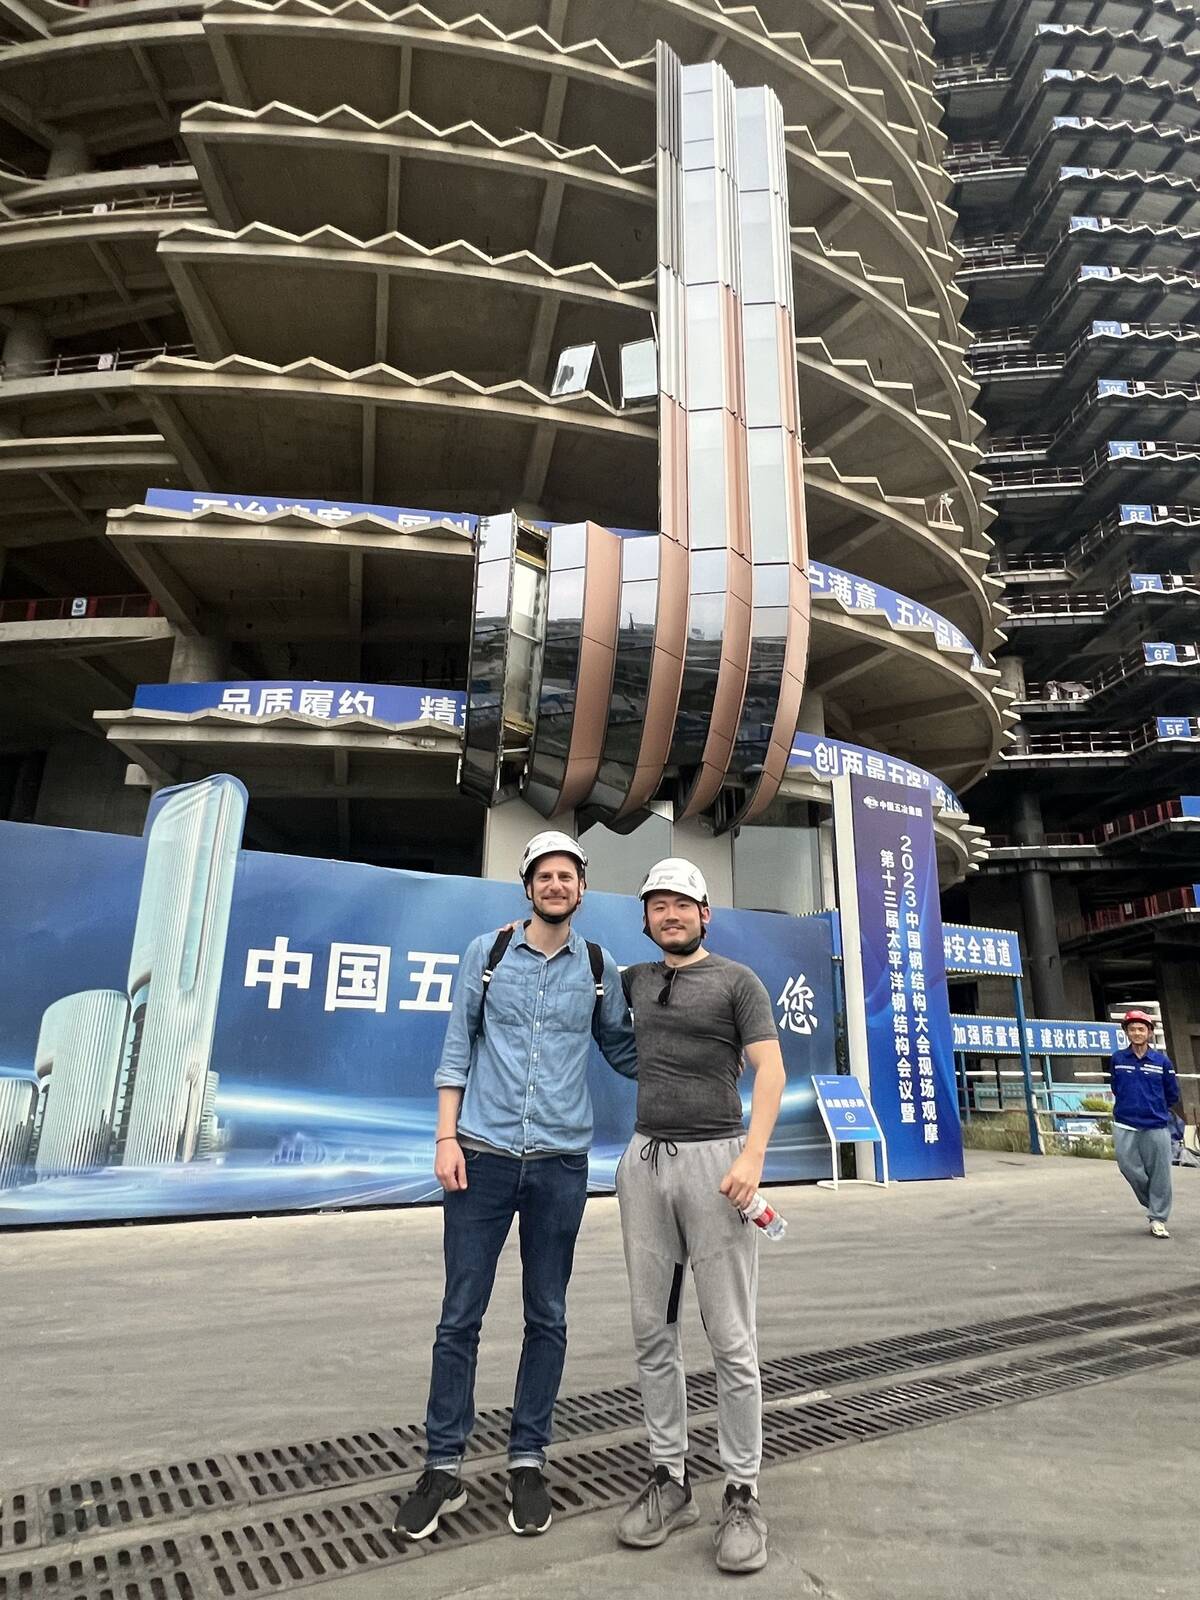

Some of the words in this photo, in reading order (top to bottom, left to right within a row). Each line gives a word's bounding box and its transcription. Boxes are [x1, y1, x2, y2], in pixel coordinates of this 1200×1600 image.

[1130, 511, 1145, 521] 8F
[1140, 580, 1156, 590] 7F
[1154, 649, 1169, 660] 6F
[217, 688, 376, 720] 品质履约
[1166, 724, 1183, 735] 5F
[880, 849, 917, 1124] 第十三届太平洋钢结构会议暨
[777, 973, 818, 1035] 您
[1041, 1028, 1112, 1050] 建设优质工程
